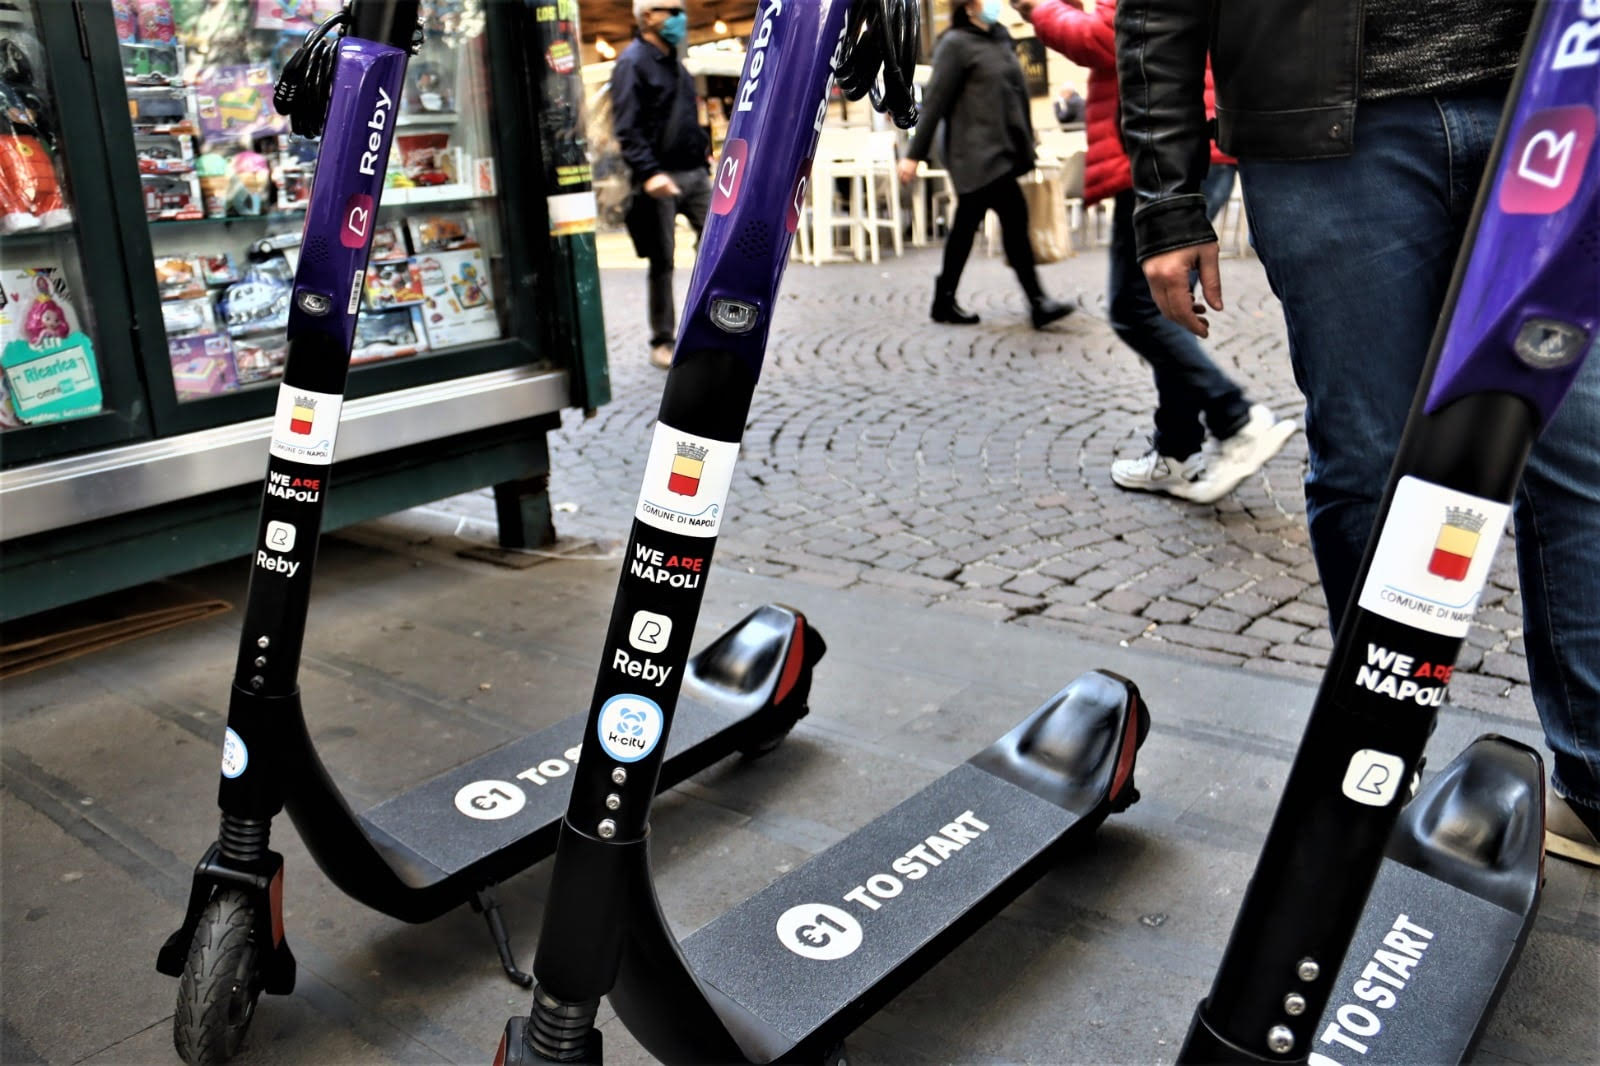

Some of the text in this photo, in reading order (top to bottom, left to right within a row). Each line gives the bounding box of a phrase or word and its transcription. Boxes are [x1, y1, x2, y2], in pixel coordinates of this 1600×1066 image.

[359, 87, 392, 175] Reby
[24, 358, 77, 384] Ricarica
[306, 450, 328, 458] NAPOLI
[267, 482, 319, 502] NAPOLI
[270, 470, 320, 490] WE ARE
[643, 503, 716, 528] COMUNE DI NAPOLI
[256, 550, 300, 578] Reby
[636, 542, 704, 572] WE ARE
[630, 559, 700, 588] NAPOLI
[1380, 589, 1434, 615] COMUNE
[1436, 607, 1449, 618] DI
[612, 648, 672, 687] Reby
[1367, 642, 1414, 677] WE
[470, 758, 570, 811] €1 TO
[795, 809, 990, 948] €1 TO START
[1320, 913, 1435, 1055] TO START
